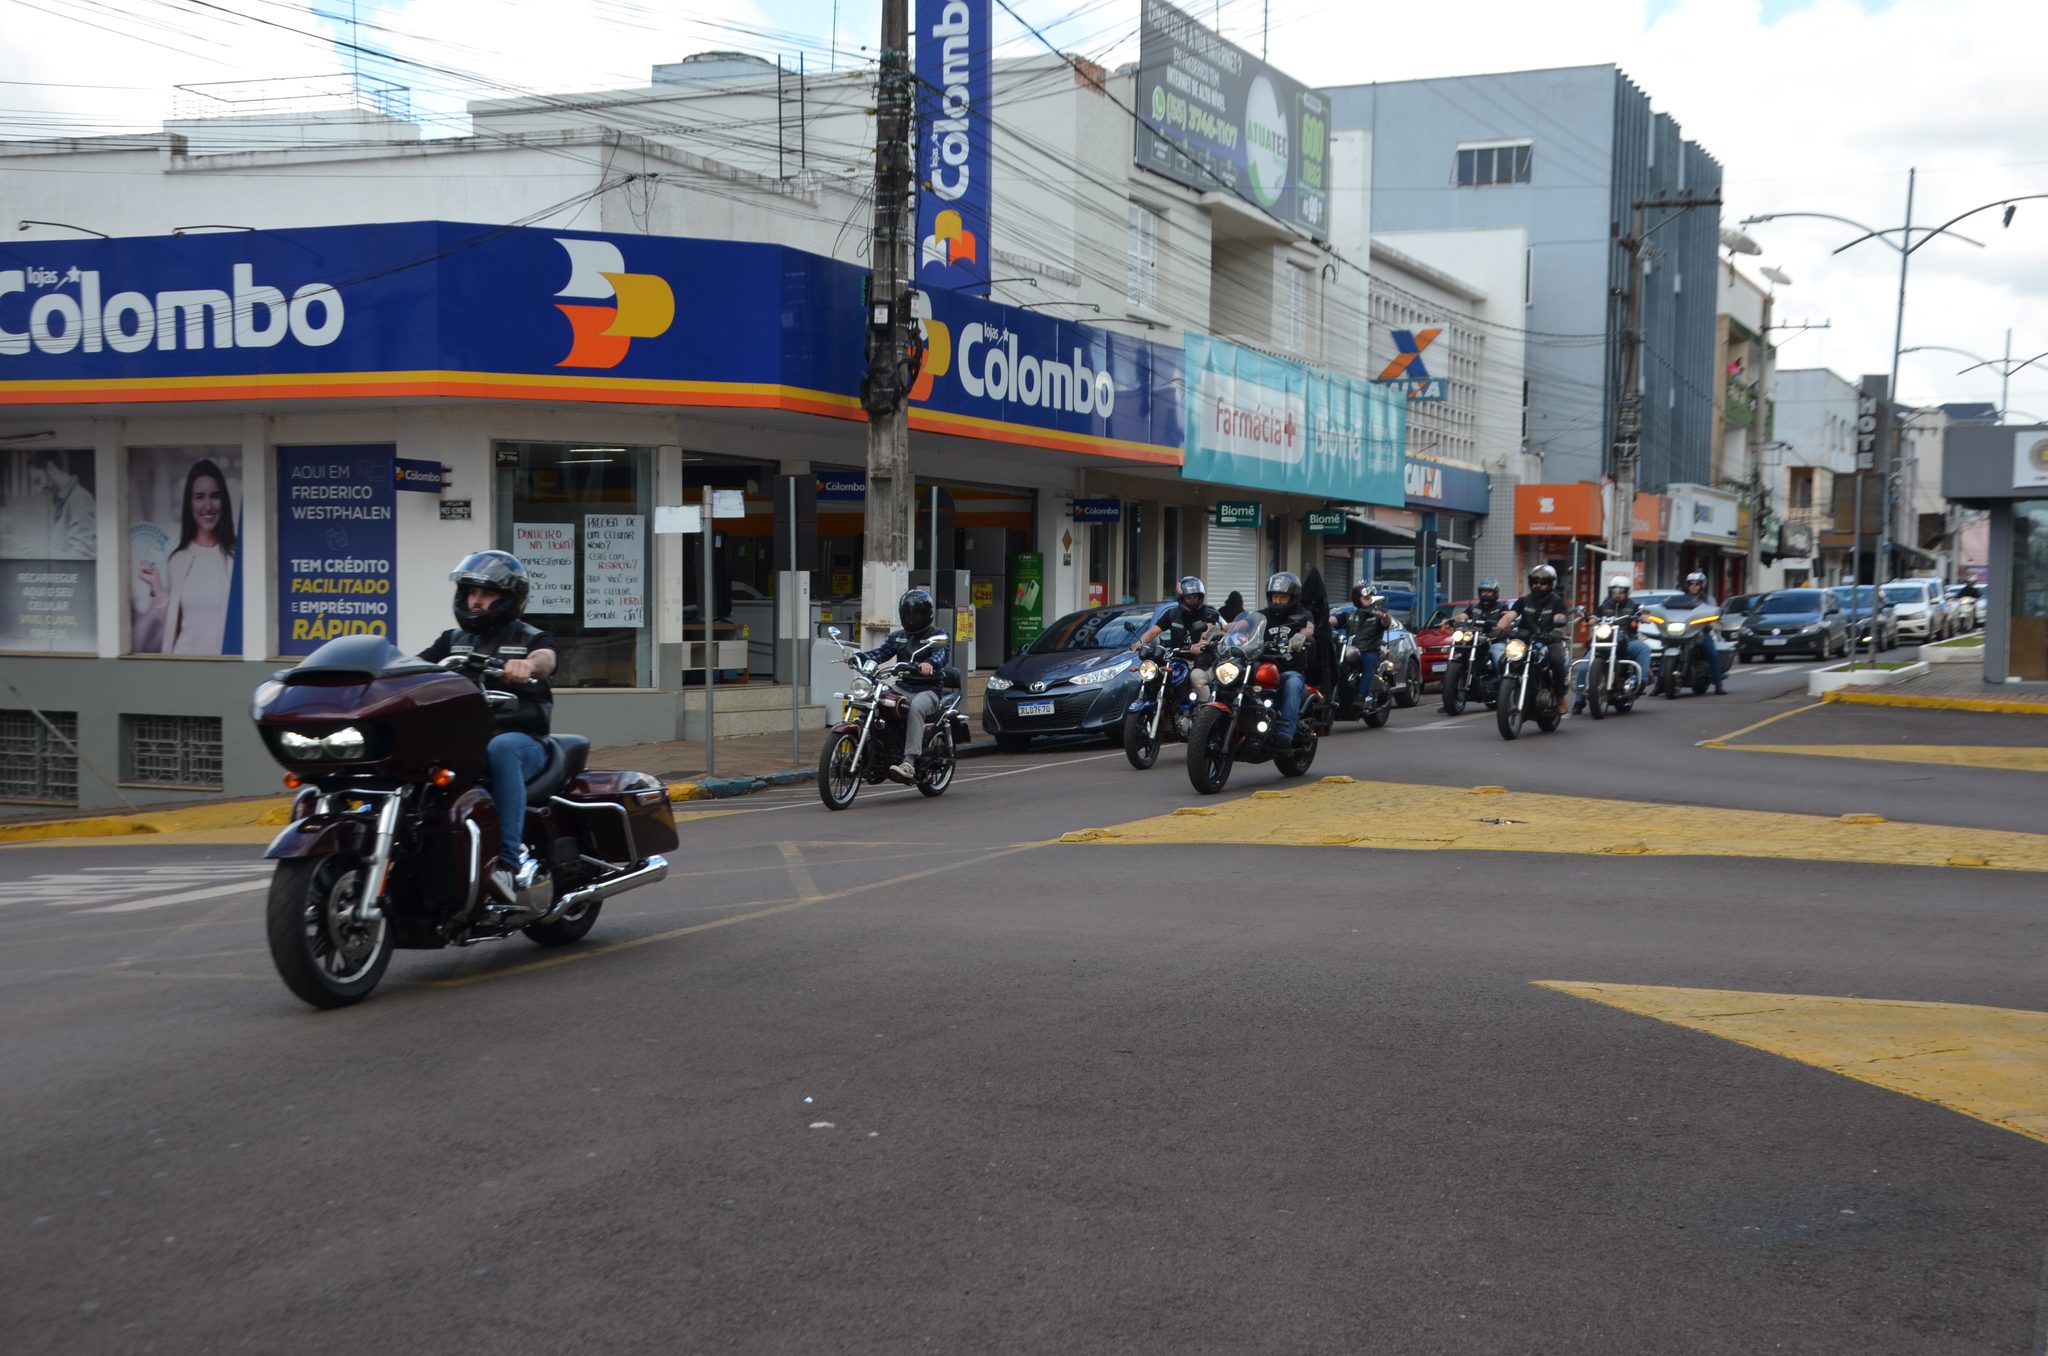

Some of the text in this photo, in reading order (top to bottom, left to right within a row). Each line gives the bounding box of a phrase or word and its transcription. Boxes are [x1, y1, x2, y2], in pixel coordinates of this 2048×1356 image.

[1167, 64, 1191, 95] INTERNET
[1191, 80, 1199, 99] DE
[932, 0, 970, 201] Colomb
[1247, 120, 1288, 159] ATUATEC
[26, 265, 58, 288] lojas
[0, 262, 345, 356] Colombo
[984, 321, 999, 342] lojas
[957, 321, 1115, 419] Colombo
[291, 465, 350, 480] AQUI EM
[405, 470, 440, 483] Colombo
[825, 480, 865, 491] Colombo
[1404, 463, 1442, 499] CAIXA
[291, 486, 373, 500] FREDERICO
[291, 506, 391, 520] WESTPHALEN
[1084, 506, 1119, 515] Colombo
[626, 517, 637, 527] DE
[517, 528, 562, 540] DINHEIRO
[291, 556, 390, 574] TEM CRÉDITO
[17, 573, 80, 583] RECARREGUE
[291, 578, 390, 594] FACILITADO
[27, 601, 70, 611] CELULAR
[291, 599, 388, 615] E EMPRÉSTIMO
[291, 612, 388, 640] RÁPIDO
